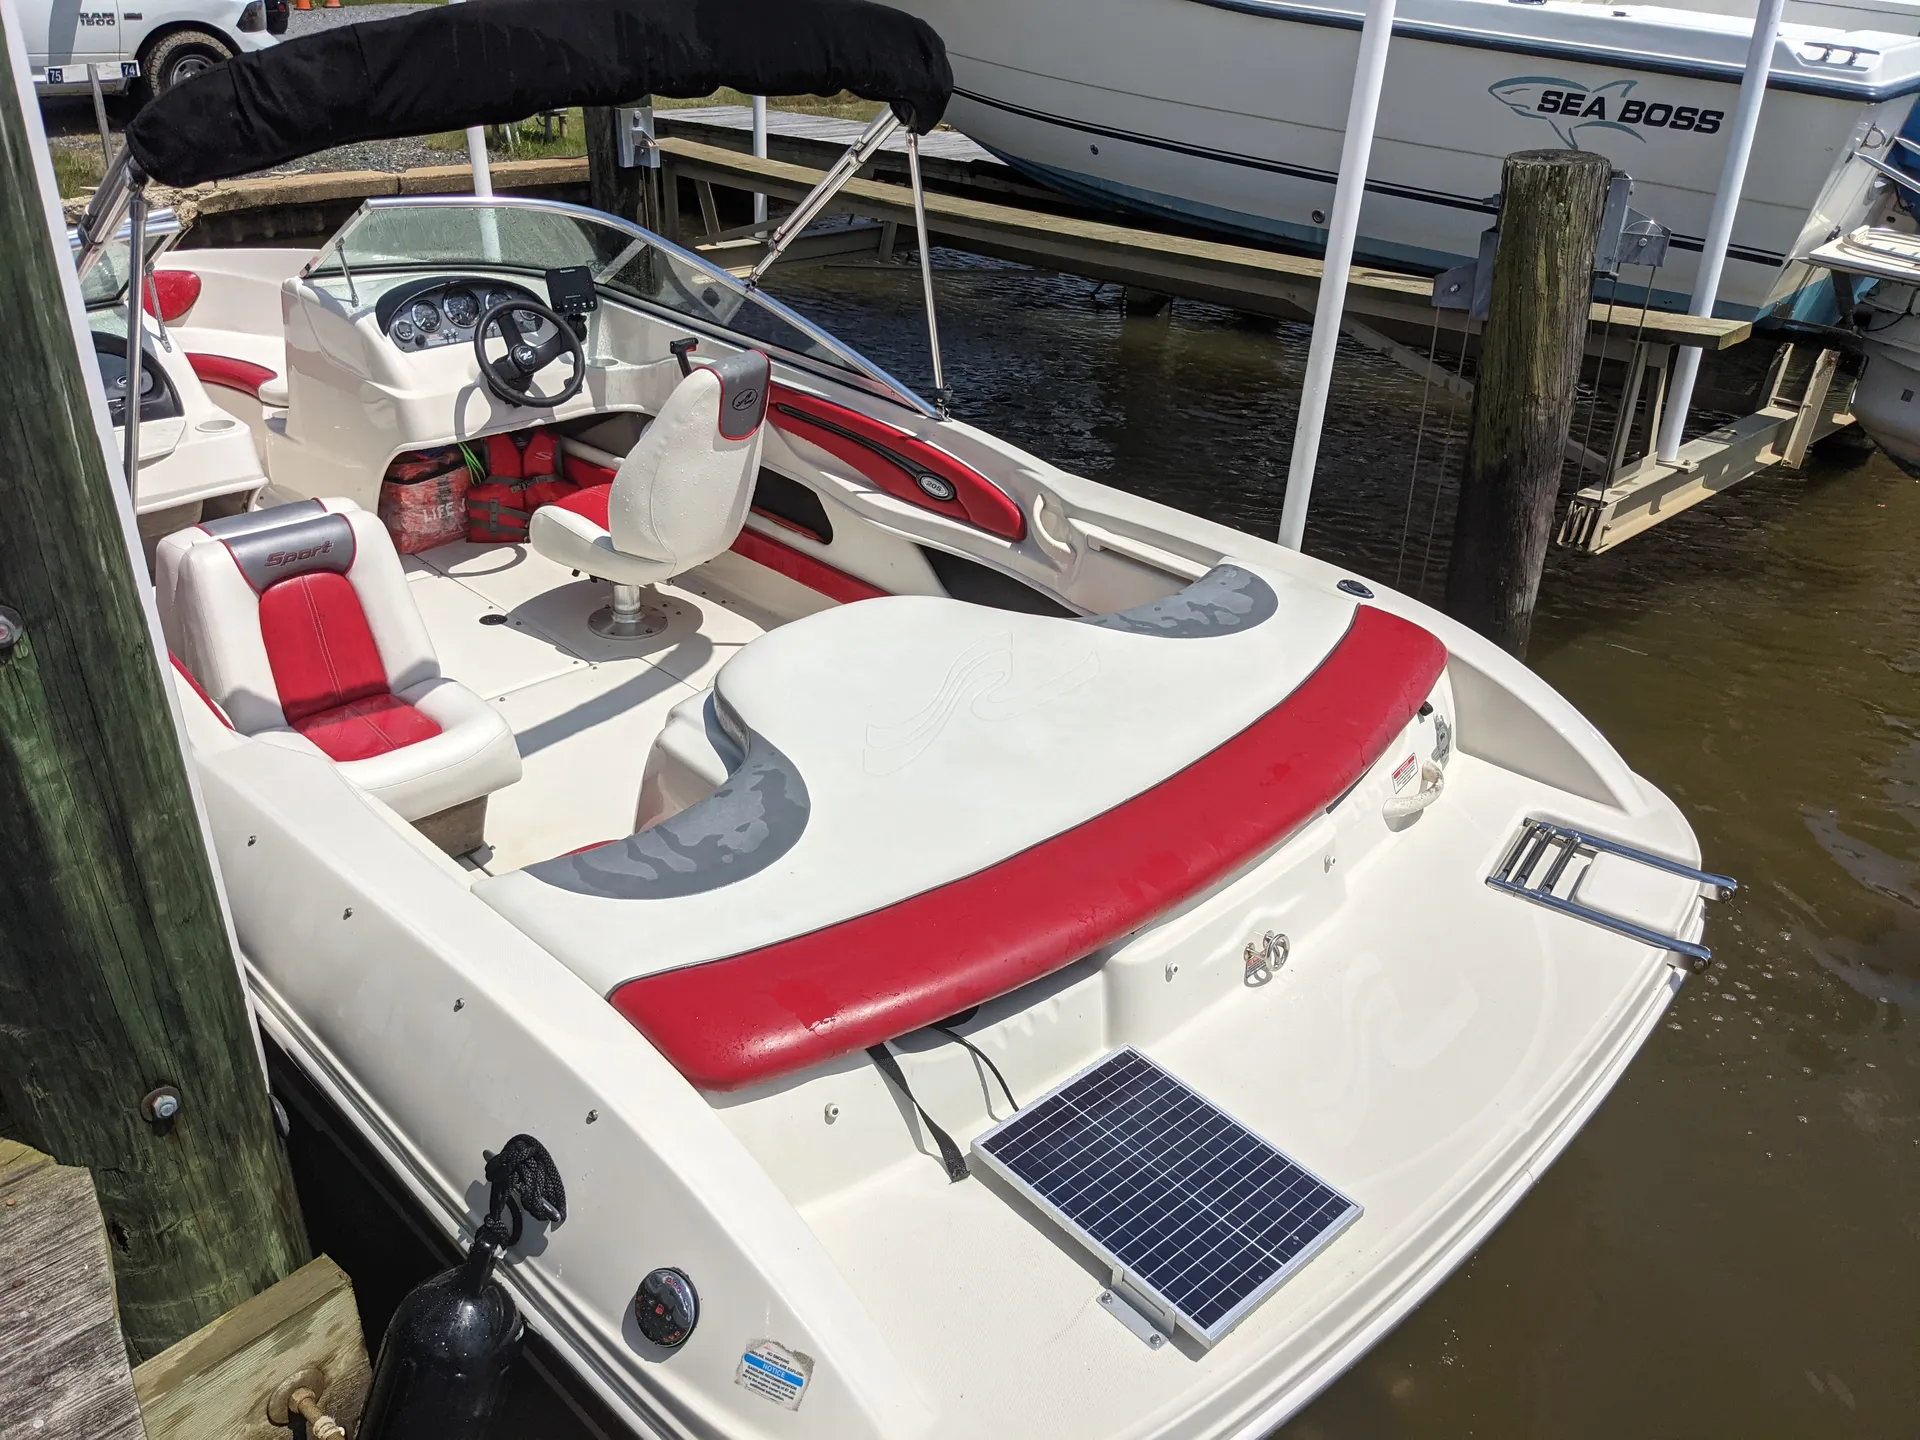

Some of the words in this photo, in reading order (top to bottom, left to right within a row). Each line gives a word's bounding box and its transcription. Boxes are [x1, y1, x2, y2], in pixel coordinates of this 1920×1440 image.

[80, 12, 115, 20] RAM
[50, 70, 62, 82] 75
[122, 64, 136, 75] 74
[1536, 90, 1606, 120] SEA
[1617, 100, 1725, 134] BOSS
[926, 480, 943, 492] 205
[423, 501, 455, 523] LIFE
[264, 540, 334, 567] Sport
[762, 1363, 786, 1378] NOTICE
